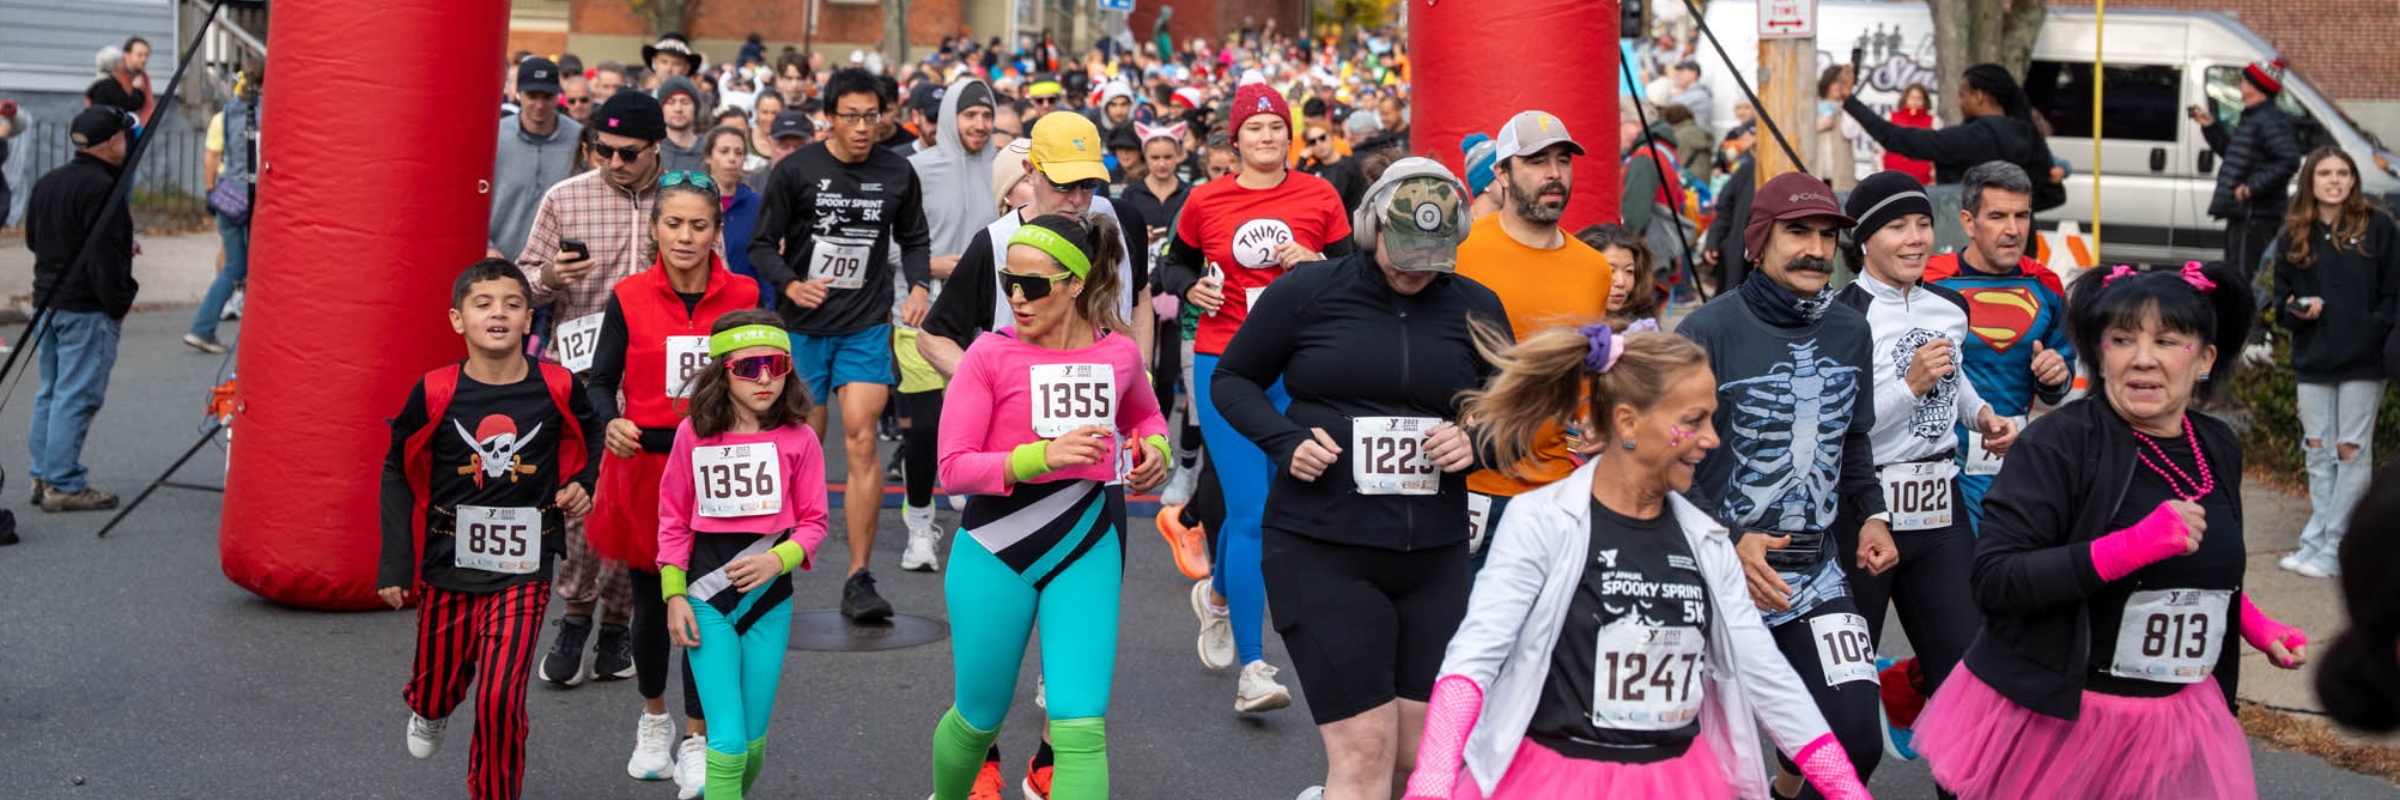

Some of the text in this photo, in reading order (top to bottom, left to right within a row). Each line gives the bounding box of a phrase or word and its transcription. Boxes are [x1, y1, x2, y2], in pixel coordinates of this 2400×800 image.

[815, 198, 884, 209] SPOOKY SPRINT
[862, 209, 881, 221] 5K
[1238, 224, 1288, 248] THING
[820, 254, 859, 279] 709
[1259, 247, 1275, 264] 2
[1039, 382, 1110, 419] 1355
[700, 460, 774, 499] 1356
[1890, 477, 1947, 514] 1022
[469, 522, 527, 557] 855
[1602, 580, 1660, 598] SPOOKY
[1683, 600, 1706, 623] 5K
[2142, 612, 2209, 659] 813
[1605, 651, 1699, 702] 1247
